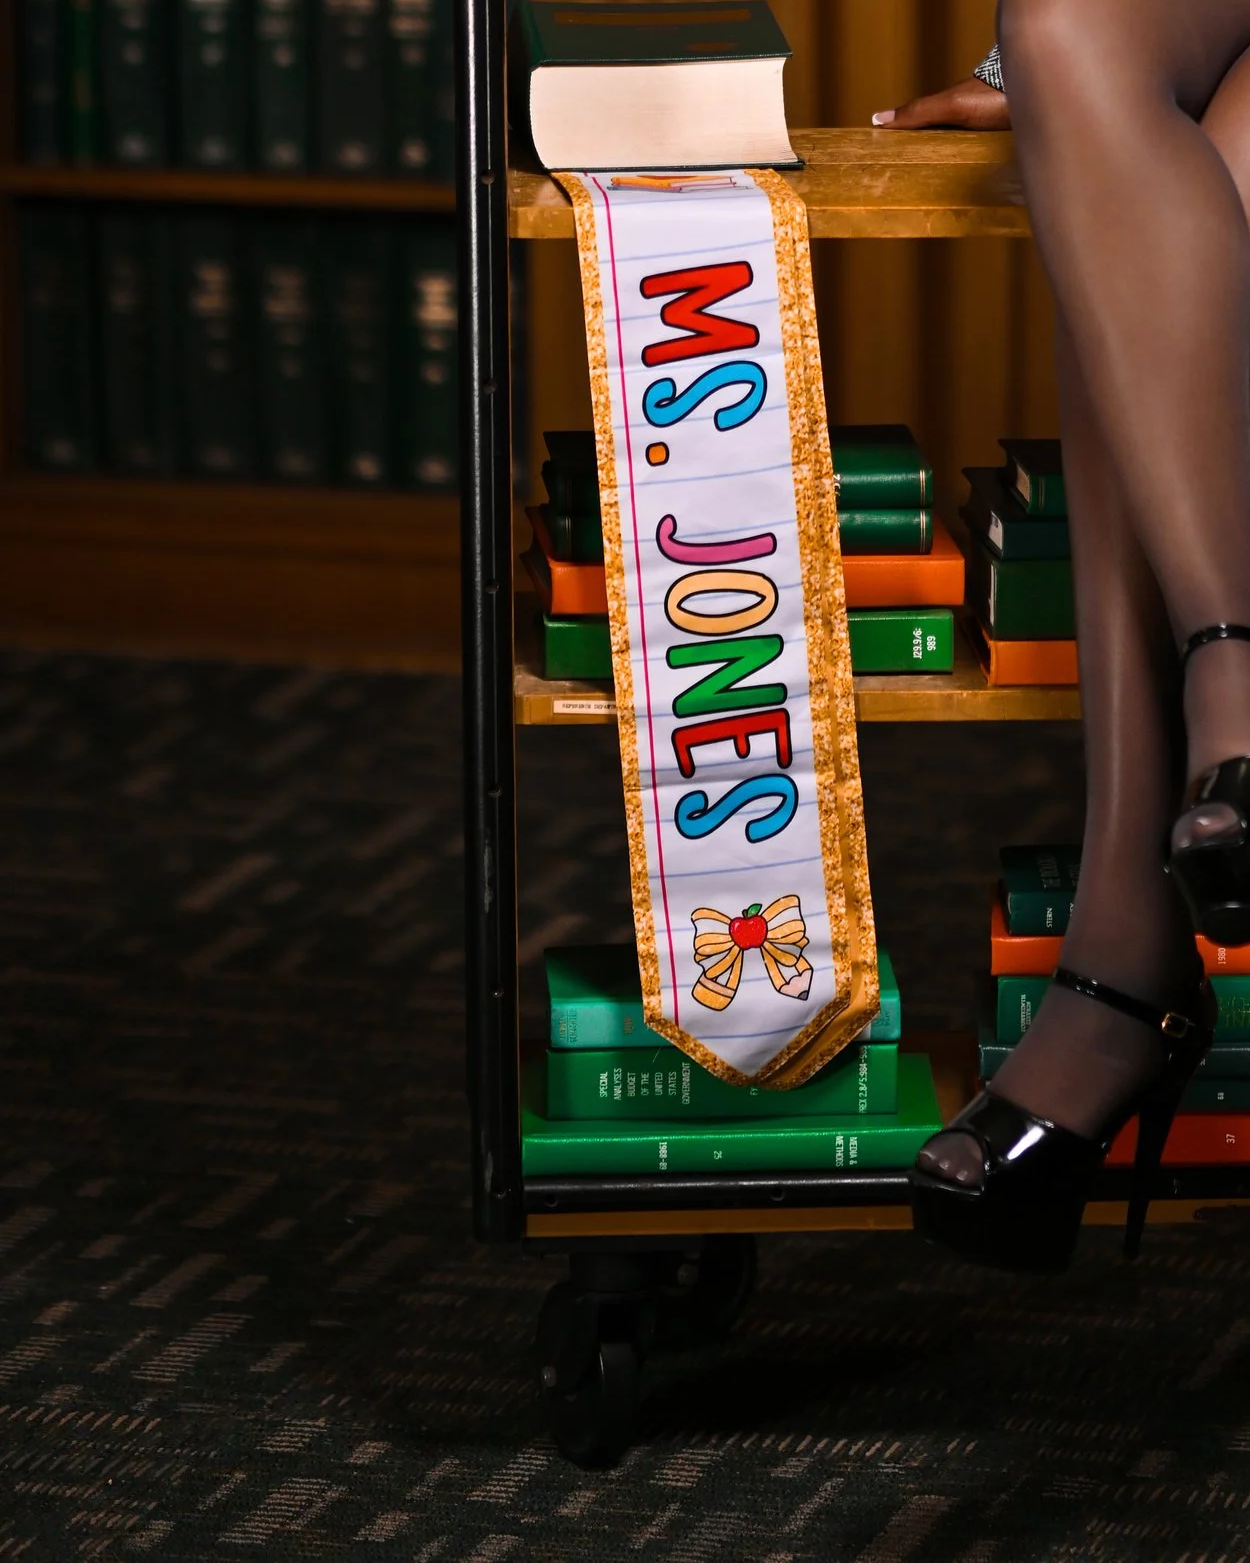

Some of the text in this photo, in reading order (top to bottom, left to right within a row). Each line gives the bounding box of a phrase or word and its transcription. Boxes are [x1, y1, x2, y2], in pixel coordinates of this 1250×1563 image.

[640, 260, 798, 843] MS. JONES
[913, 628, 922, 660] J29.9/6:
[927, 635, 936, 651] 989
[1218, 948, 1226, 965] 1980
[600, 1071, 608, 1098] SPECIAL
[614, 1067, 622, 1101] ANALYSES
[627, 1072, 636, 1097] BUDGET
[641, 1072, 649, 1096] OF THE
[655, 1072, 663, 1096] UNITED
[668, 1071, 677, 1096] STATES
[682, 1062, 690, 1105] GOVERNMENT
[858, 1099, 867, 1114] PREX
[835, 1135, 844, 1167] METHODS
[849, 1137, 858, 1159] MEDIA
[1226, 1134, 1235, 1145] 37
[659, 1141, 667, 1170] 1988-89
[714, 1151, 722, 1159] 25
